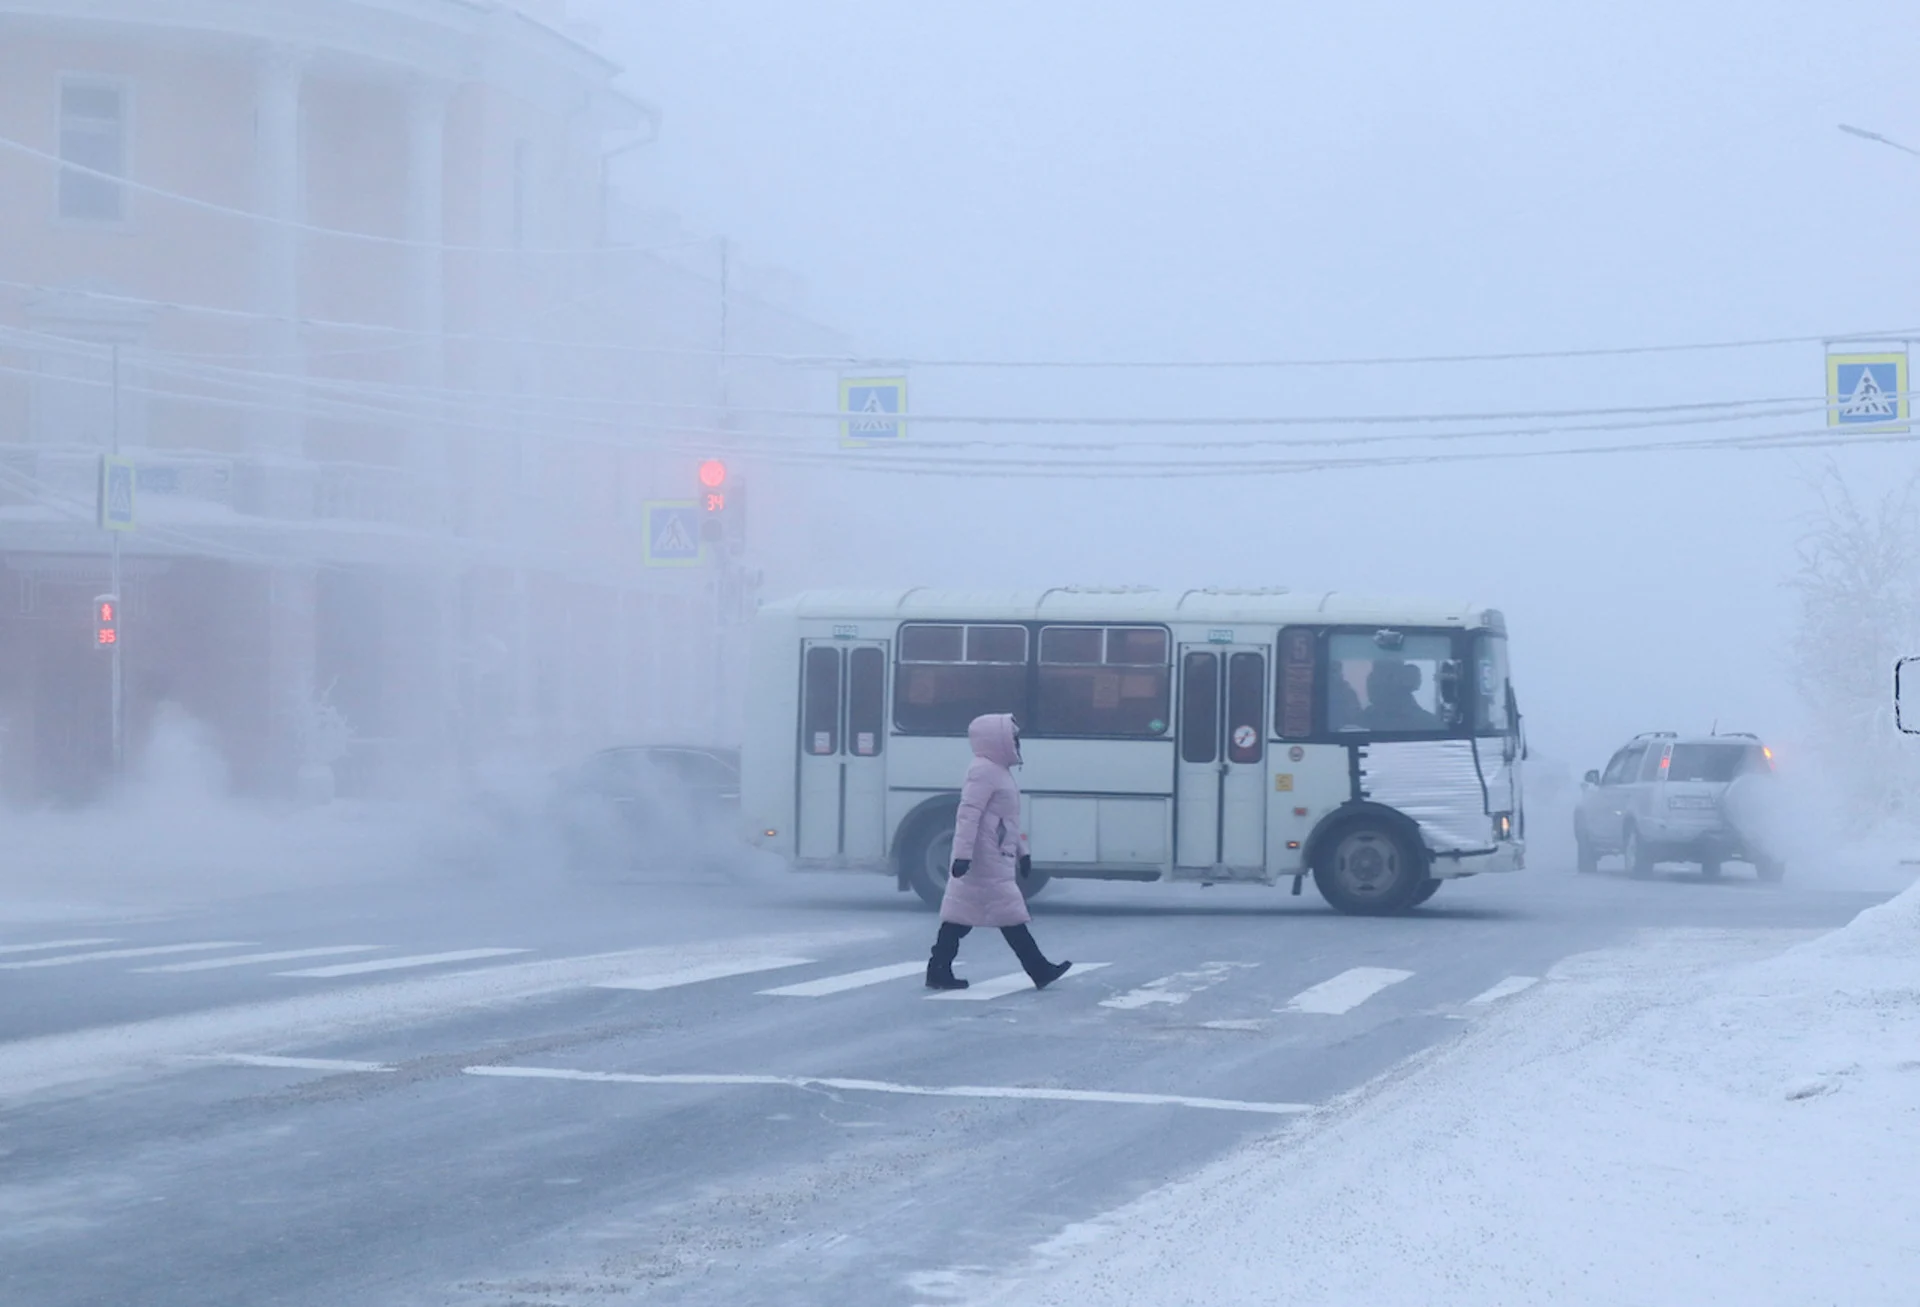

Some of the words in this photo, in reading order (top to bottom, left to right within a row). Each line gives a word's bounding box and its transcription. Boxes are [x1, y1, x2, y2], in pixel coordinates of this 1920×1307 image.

[707, 494, 725, 511] 34
[99, 629, 116, 643] 35
[1292, 637, 1307, 660] 5
